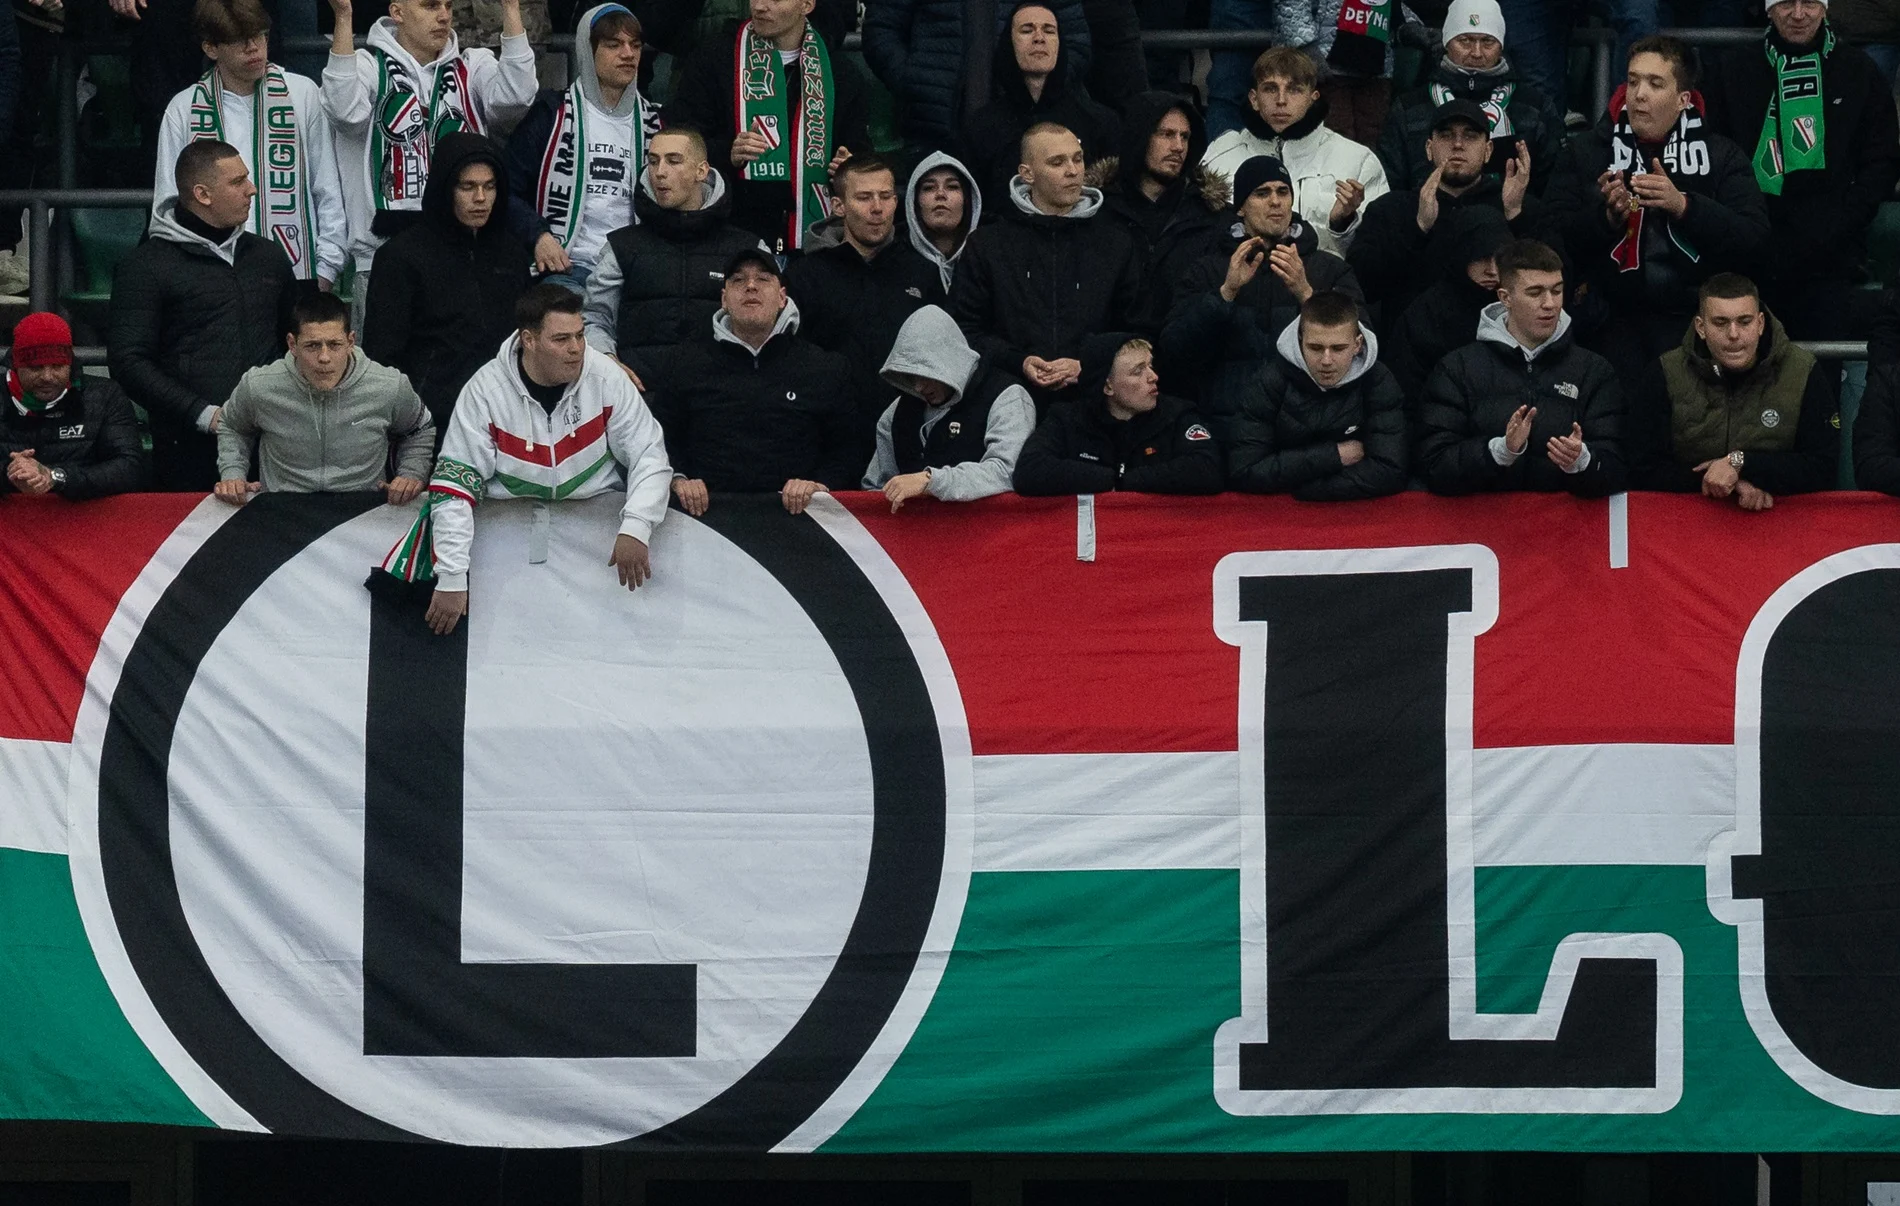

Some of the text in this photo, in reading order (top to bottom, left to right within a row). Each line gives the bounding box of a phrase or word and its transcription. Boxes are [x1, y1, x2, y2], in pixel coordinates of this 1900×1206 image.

[267, 103, 297, 218] LEGIA
[752, 161, 785, 179] 1916
[548, 183, 572, 229] NIE
[363, 567, 698, 1058] L
